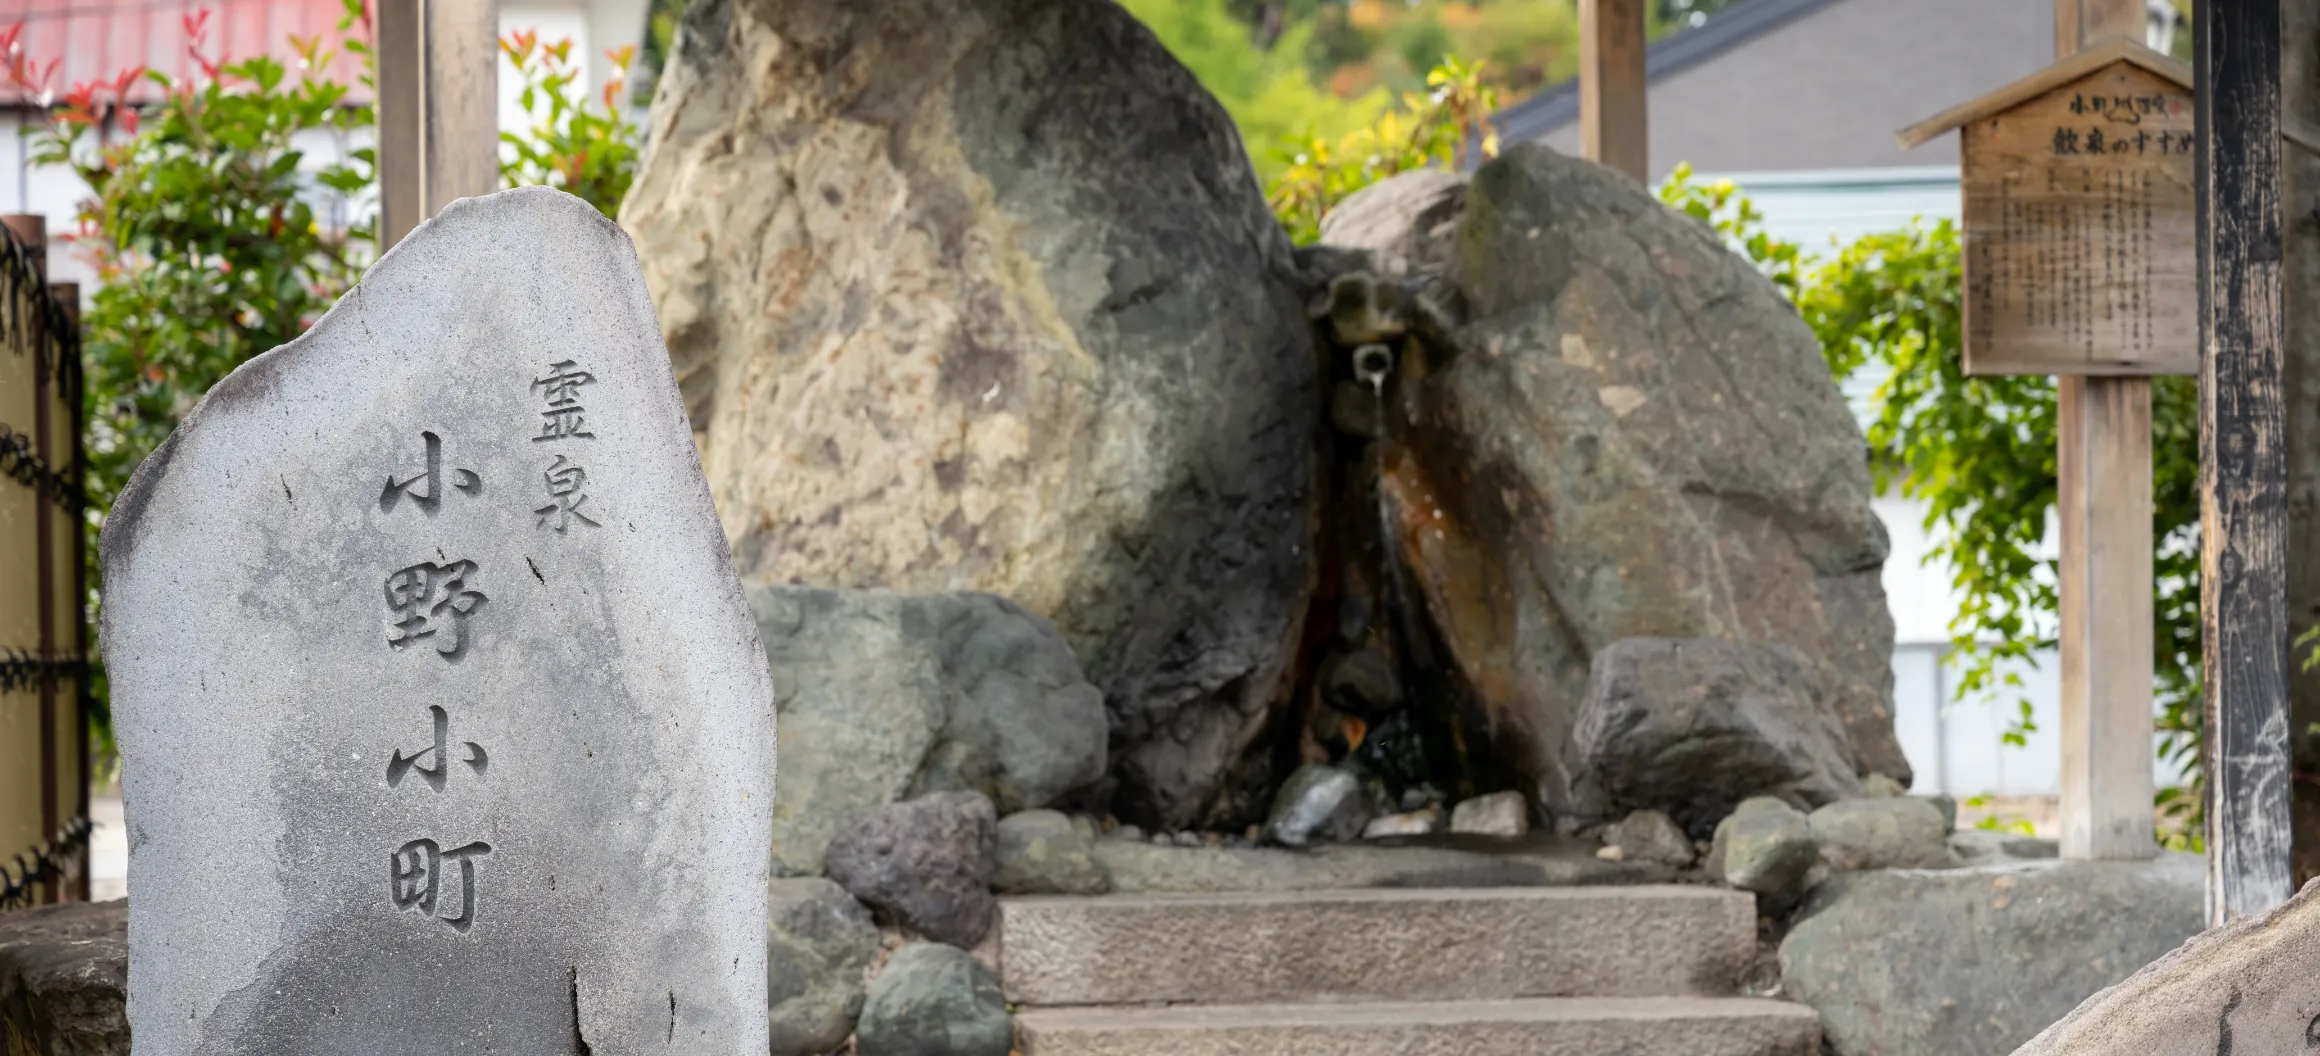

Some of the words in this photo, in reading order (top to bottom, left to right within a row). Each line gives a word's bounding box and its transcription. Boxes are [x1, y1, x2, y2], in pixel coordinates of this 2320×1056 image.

[530, 359, 602, 532] 霊泉
[380, 431, 492, 933] 小野小町
